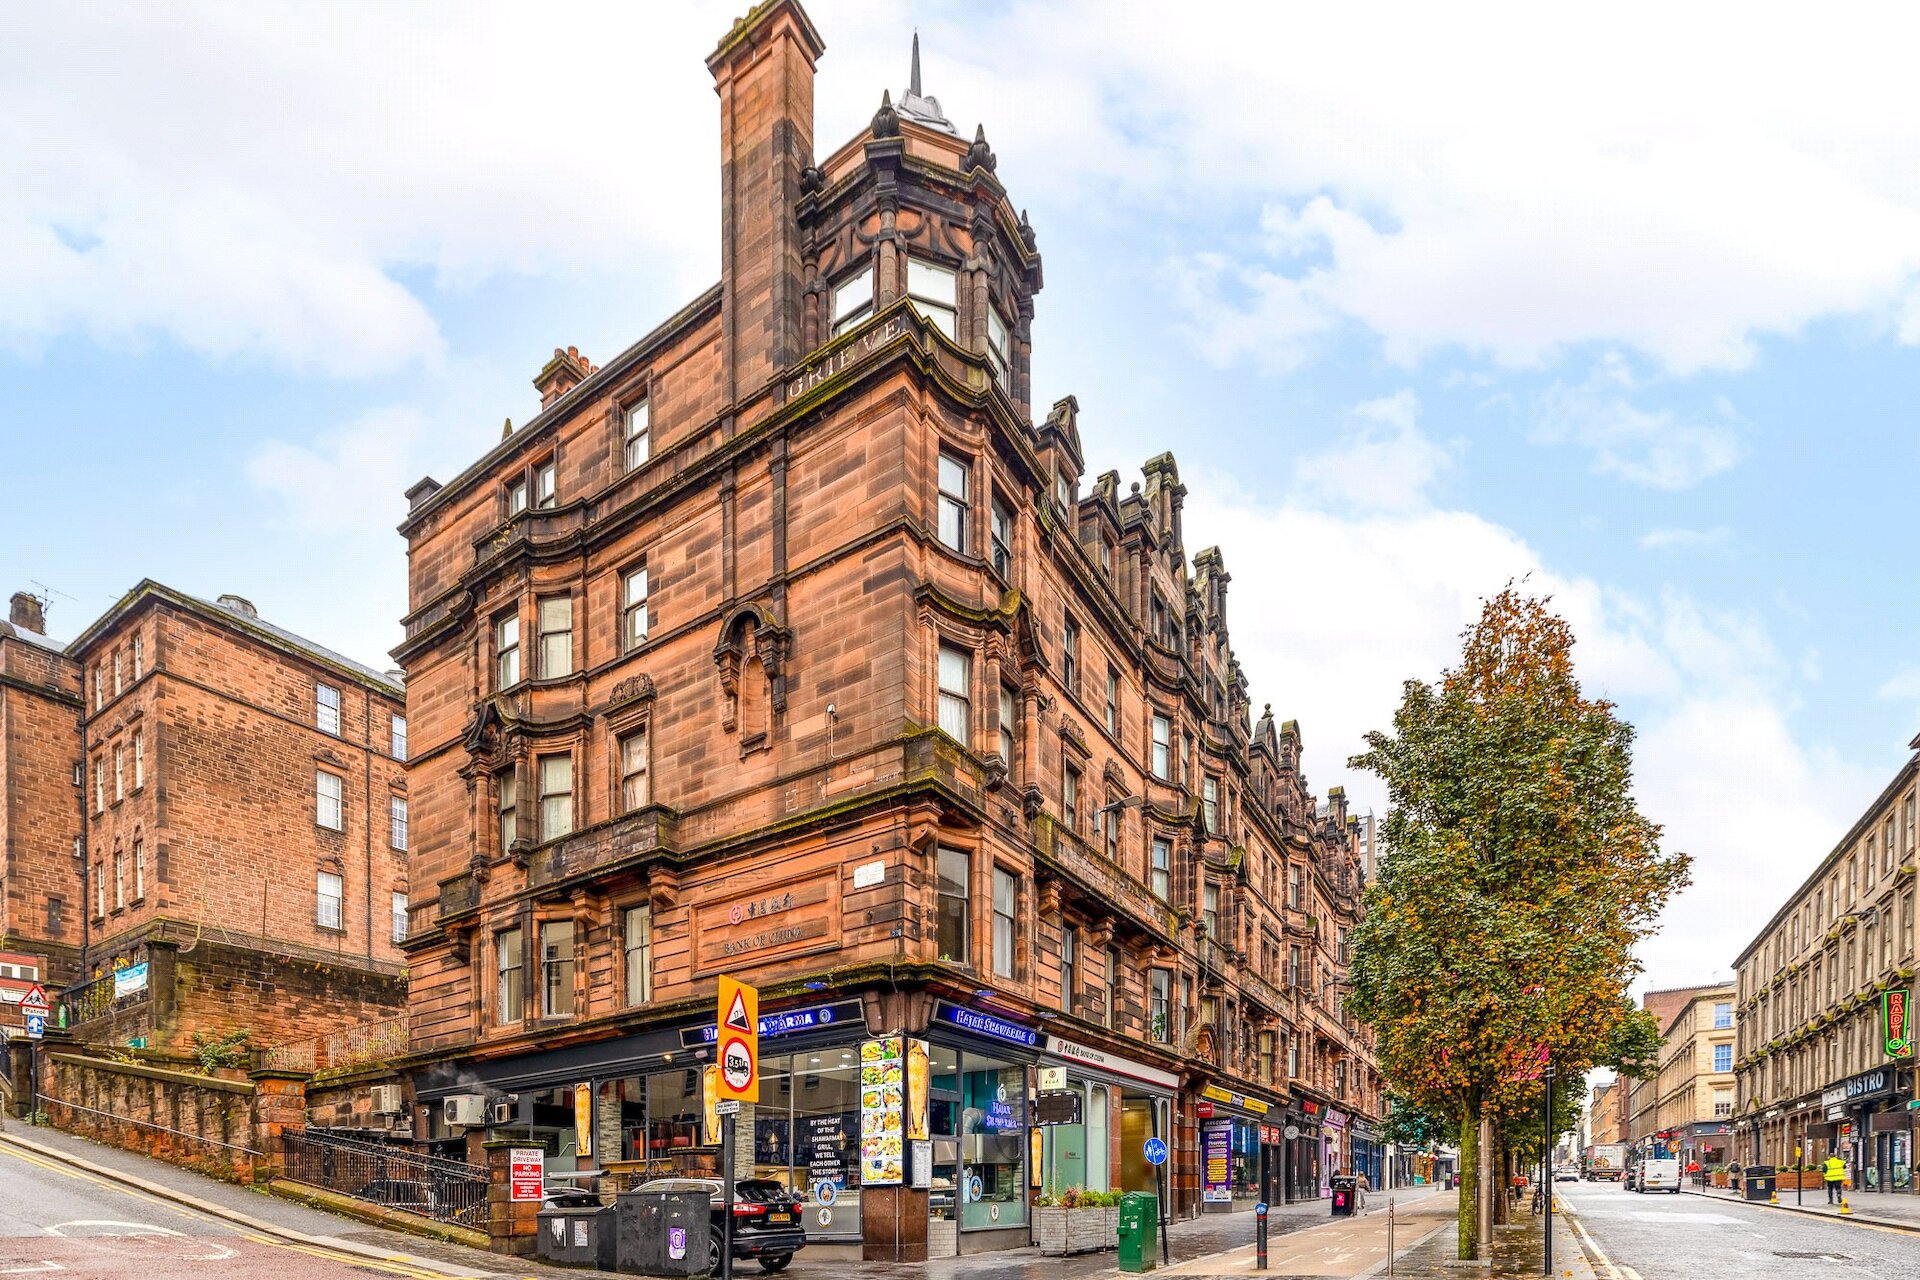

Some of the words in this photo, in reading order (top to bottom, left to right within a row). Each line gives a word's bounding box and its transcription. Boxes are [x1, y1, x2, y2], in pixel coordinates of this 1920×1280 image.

[724, 938, 751, 954] BANK
[753, 933, 767, 946] OF
[768, 927, 803, 944] CHINA
[1889, 993, 1904, 1050] RADIO
[1080, 1050, 1090, 1059] BANK
[1094, 1054, 1105, 1063] CHINA
[1846, 1071, 1884, 1097] BISTRO
[811, 1135, 840, 1143] SHAWARMA
[824, 1159, 841, 1167] OTHER
